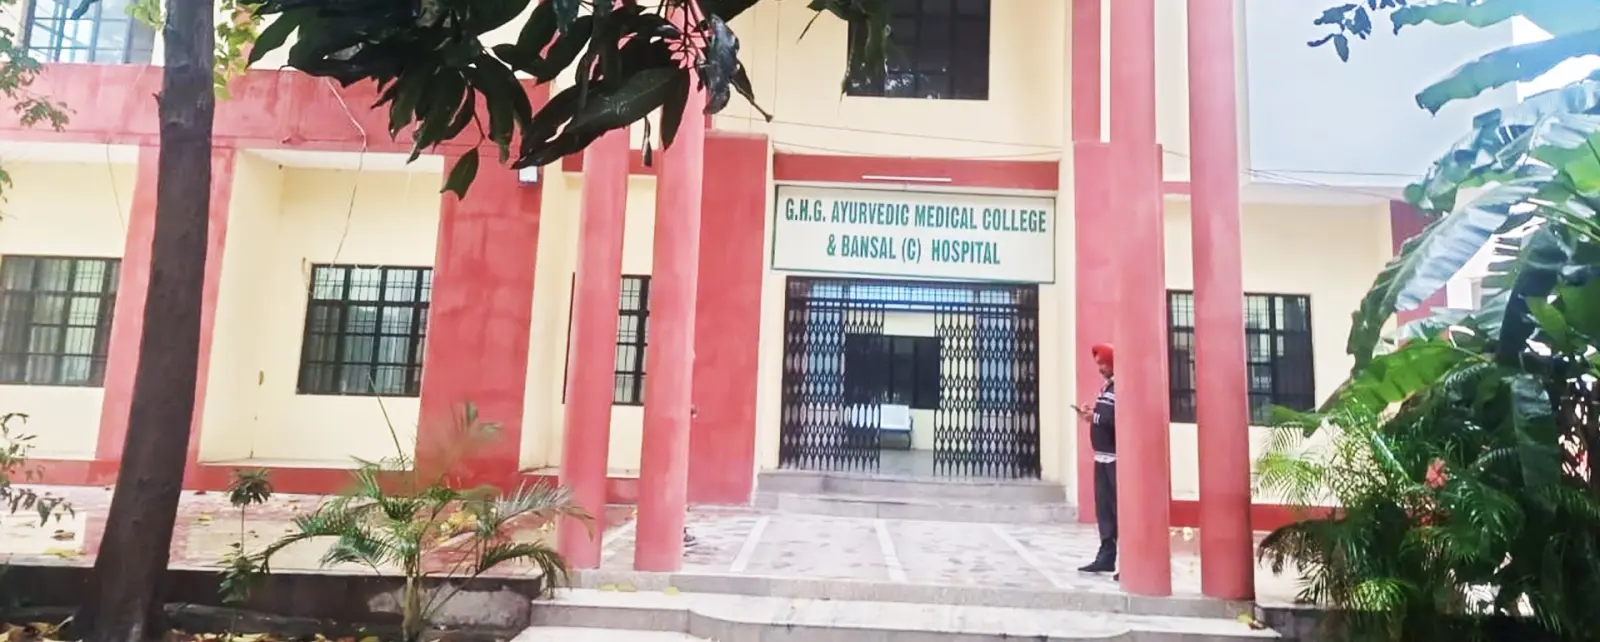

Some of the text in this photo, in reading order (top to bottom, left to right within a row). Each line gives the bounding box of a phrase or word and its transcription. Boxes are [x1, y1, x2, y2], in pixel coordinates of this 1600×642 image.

[785, 198, 1047, 233] G.H.G. AYURVEDIC MEDICAL COLLEGE
[826, 233, 1001, 265] & BANSAL (C) HOSPITAL
